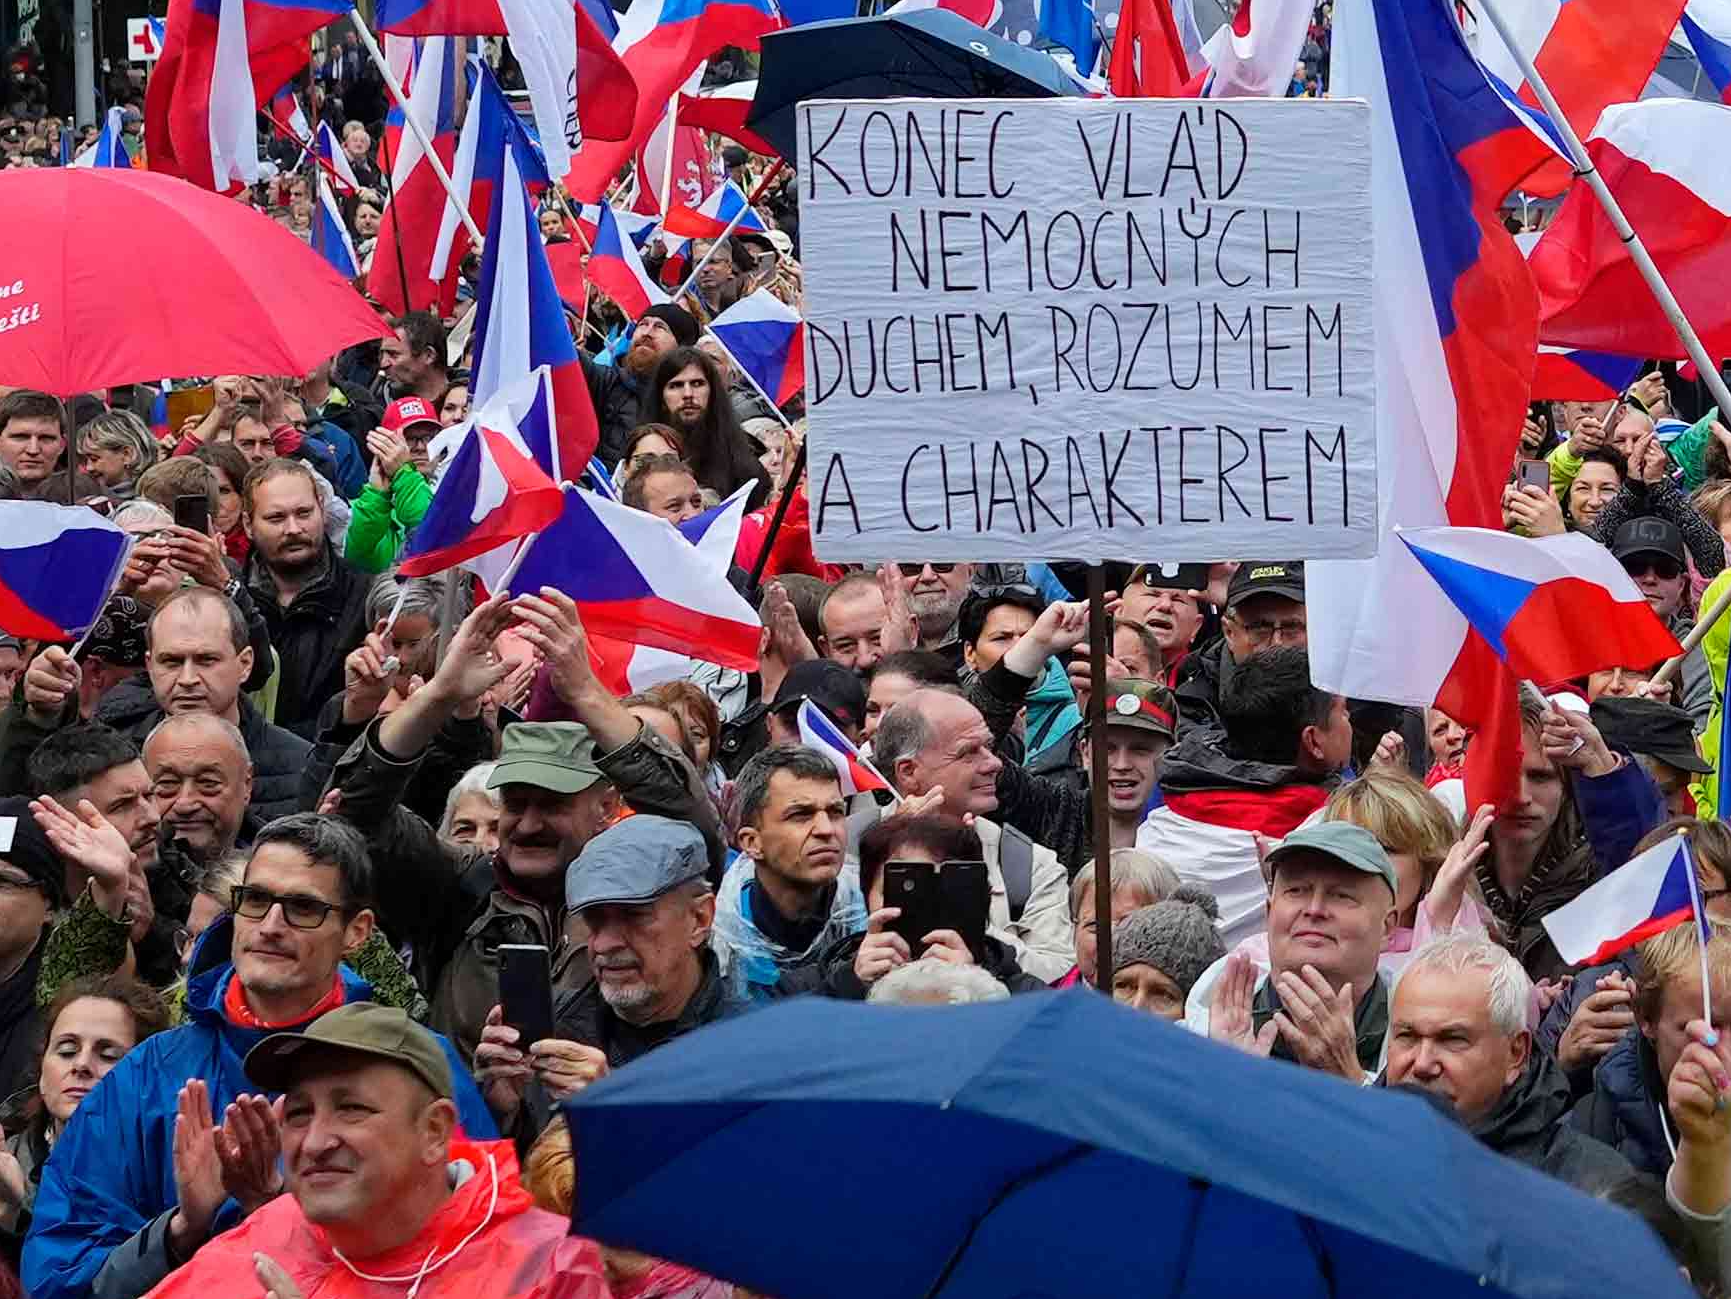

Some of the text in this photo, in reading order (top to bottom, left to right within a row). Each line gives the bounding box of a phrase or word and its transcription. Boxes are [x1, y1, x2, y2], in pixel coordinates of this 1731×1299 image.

[805, 104, 1250, 201] KONEC VLÁD
[890, 195, 1302, 294] NEMOCNÝCH
[807, 301, 1344, 408] DUCHEM, ROZUMEM
[815, 423, 1350, 536] A CHARAKTEREM
